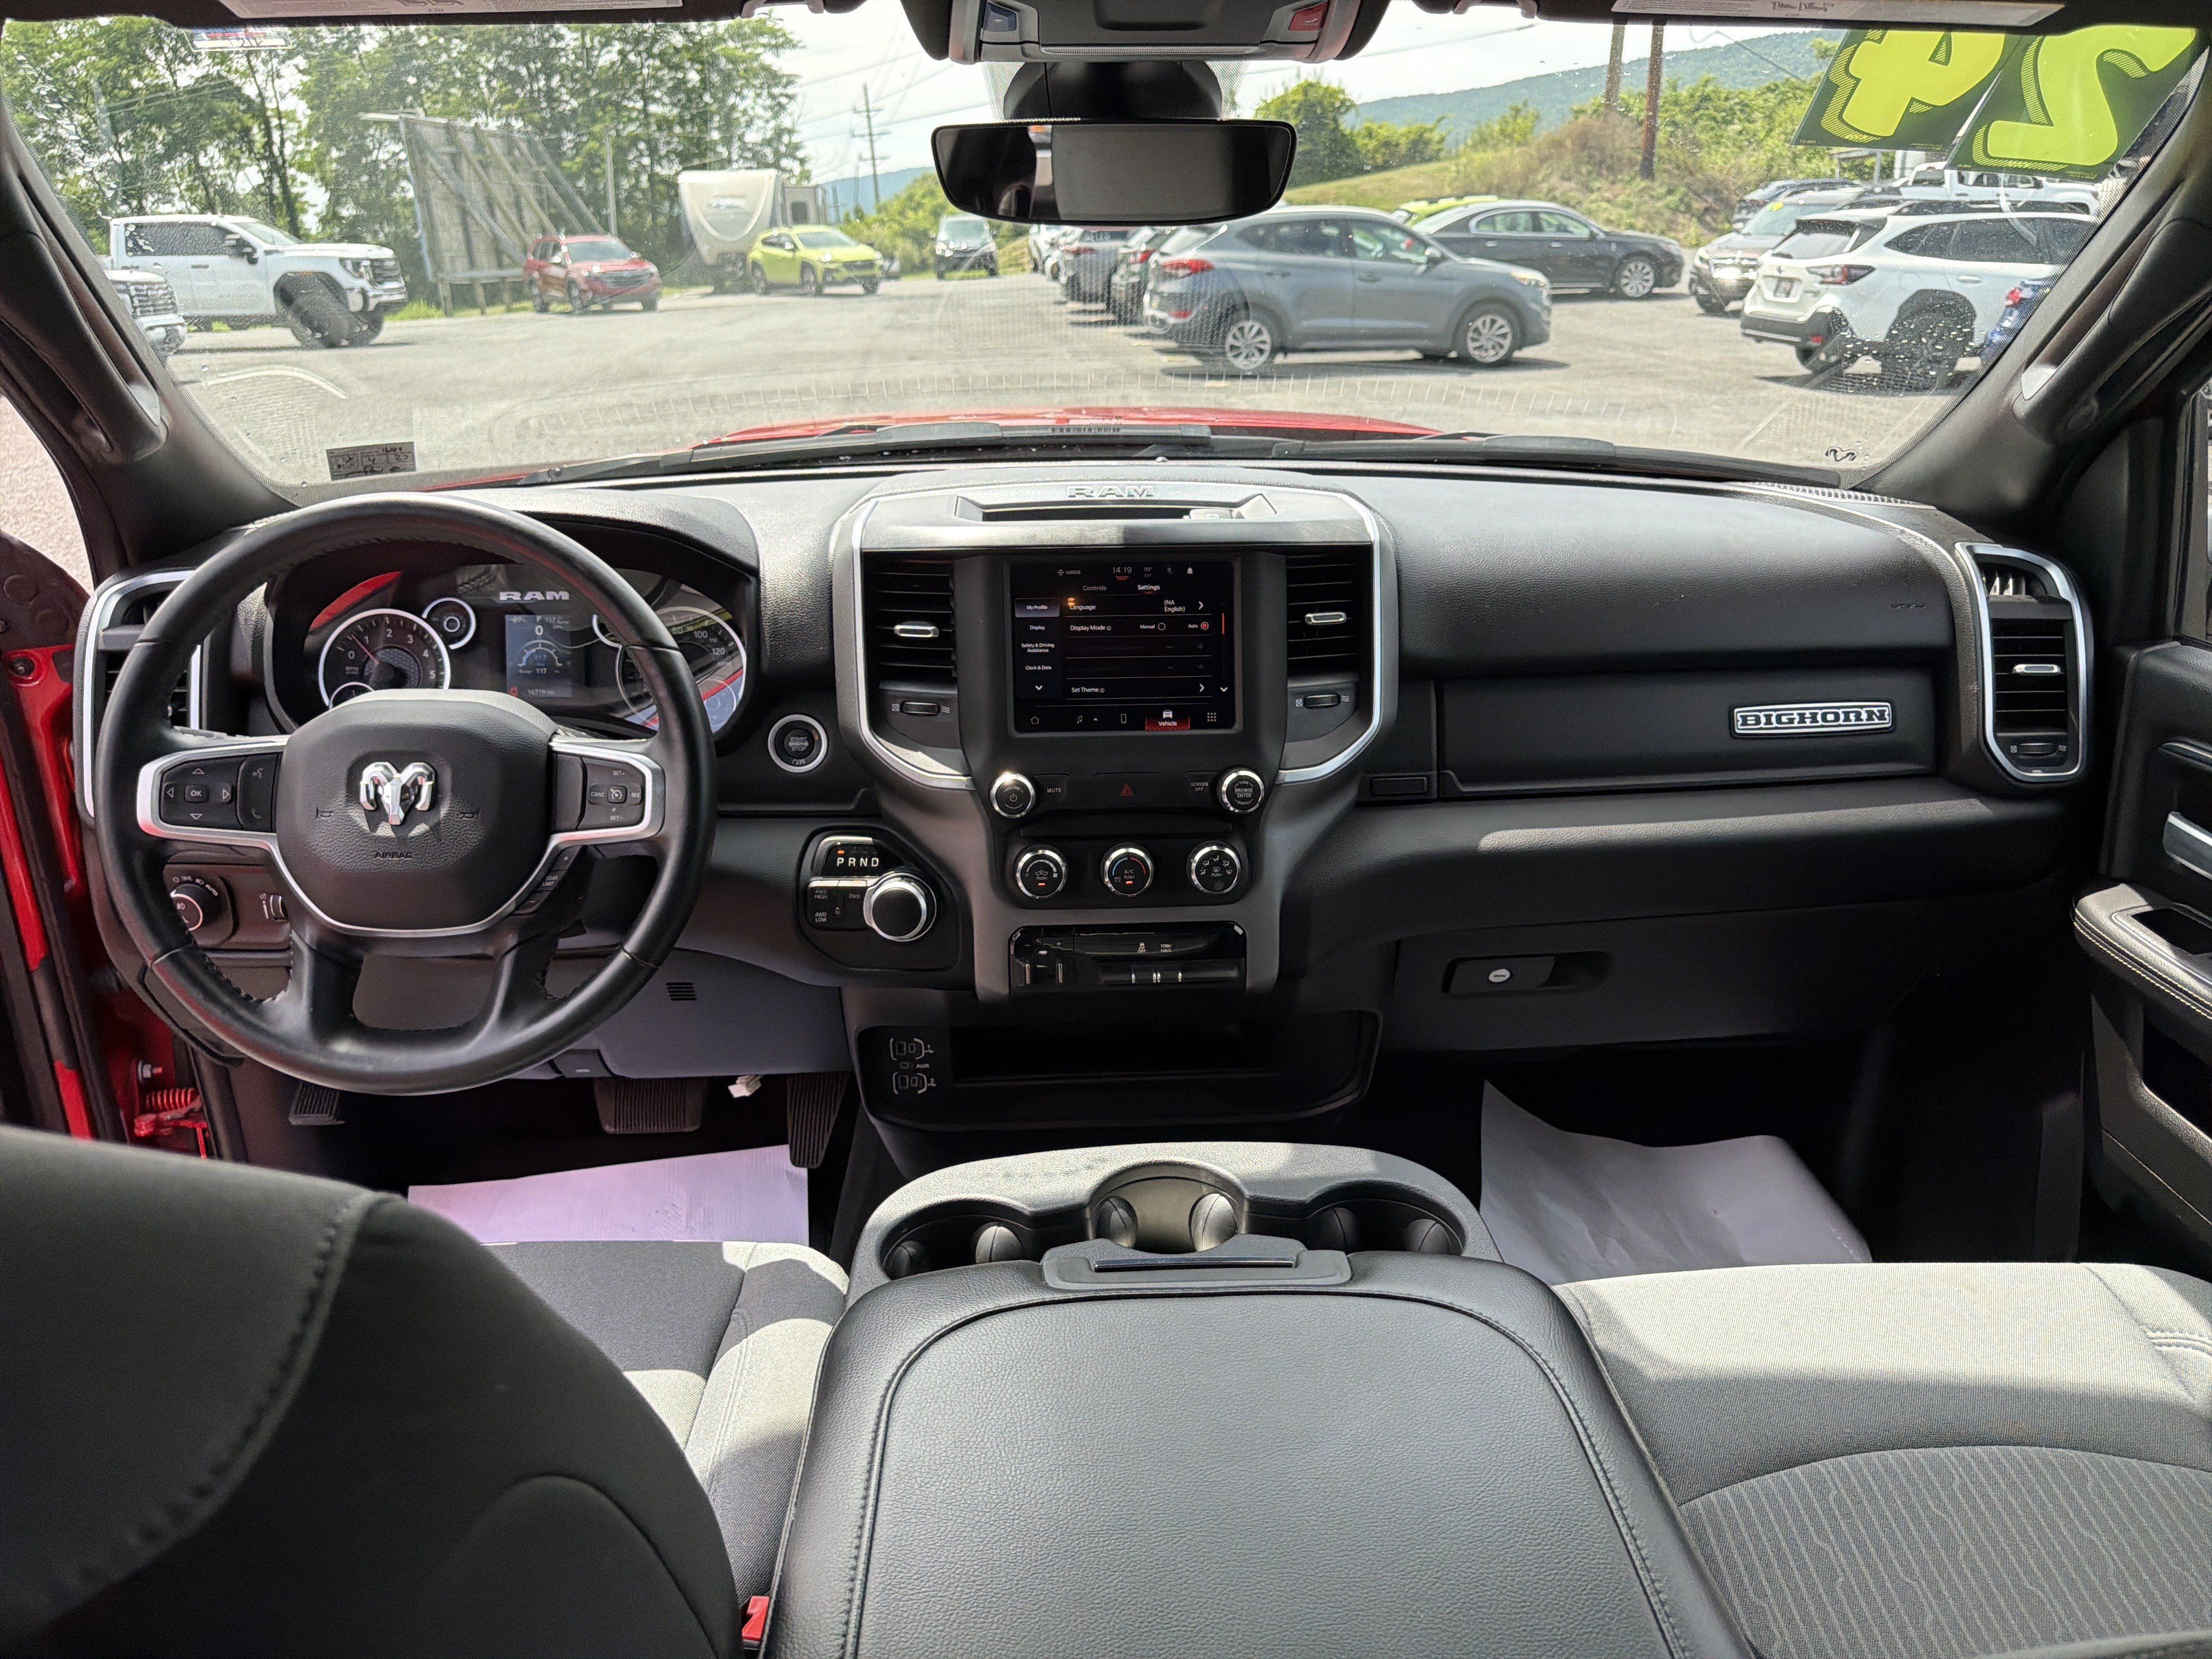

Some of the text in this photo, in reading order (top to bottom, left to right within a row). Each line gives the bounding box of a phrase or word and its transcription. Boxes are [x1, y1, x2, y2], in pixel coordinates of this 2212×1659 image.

[1067, 486, 1154, 498] RAM
[500, 591, 569, 601] RAM
[387, 629, 393, 637] 2
[535, 625, 544, 636] 0
[693, 630, 708, 639] 100
[364, 636, 369, 644] 1
[407, 634, 414, 644] 3
[348, 651, 355, 659] 0
[422, 649, 429, 658] 4
[712, 647, 725, 656] 120
[430, 670, 436, 679] 5
[1737, 707, 1890, 730] BIGHORN
[205, 884, 218, 896] AUTO
